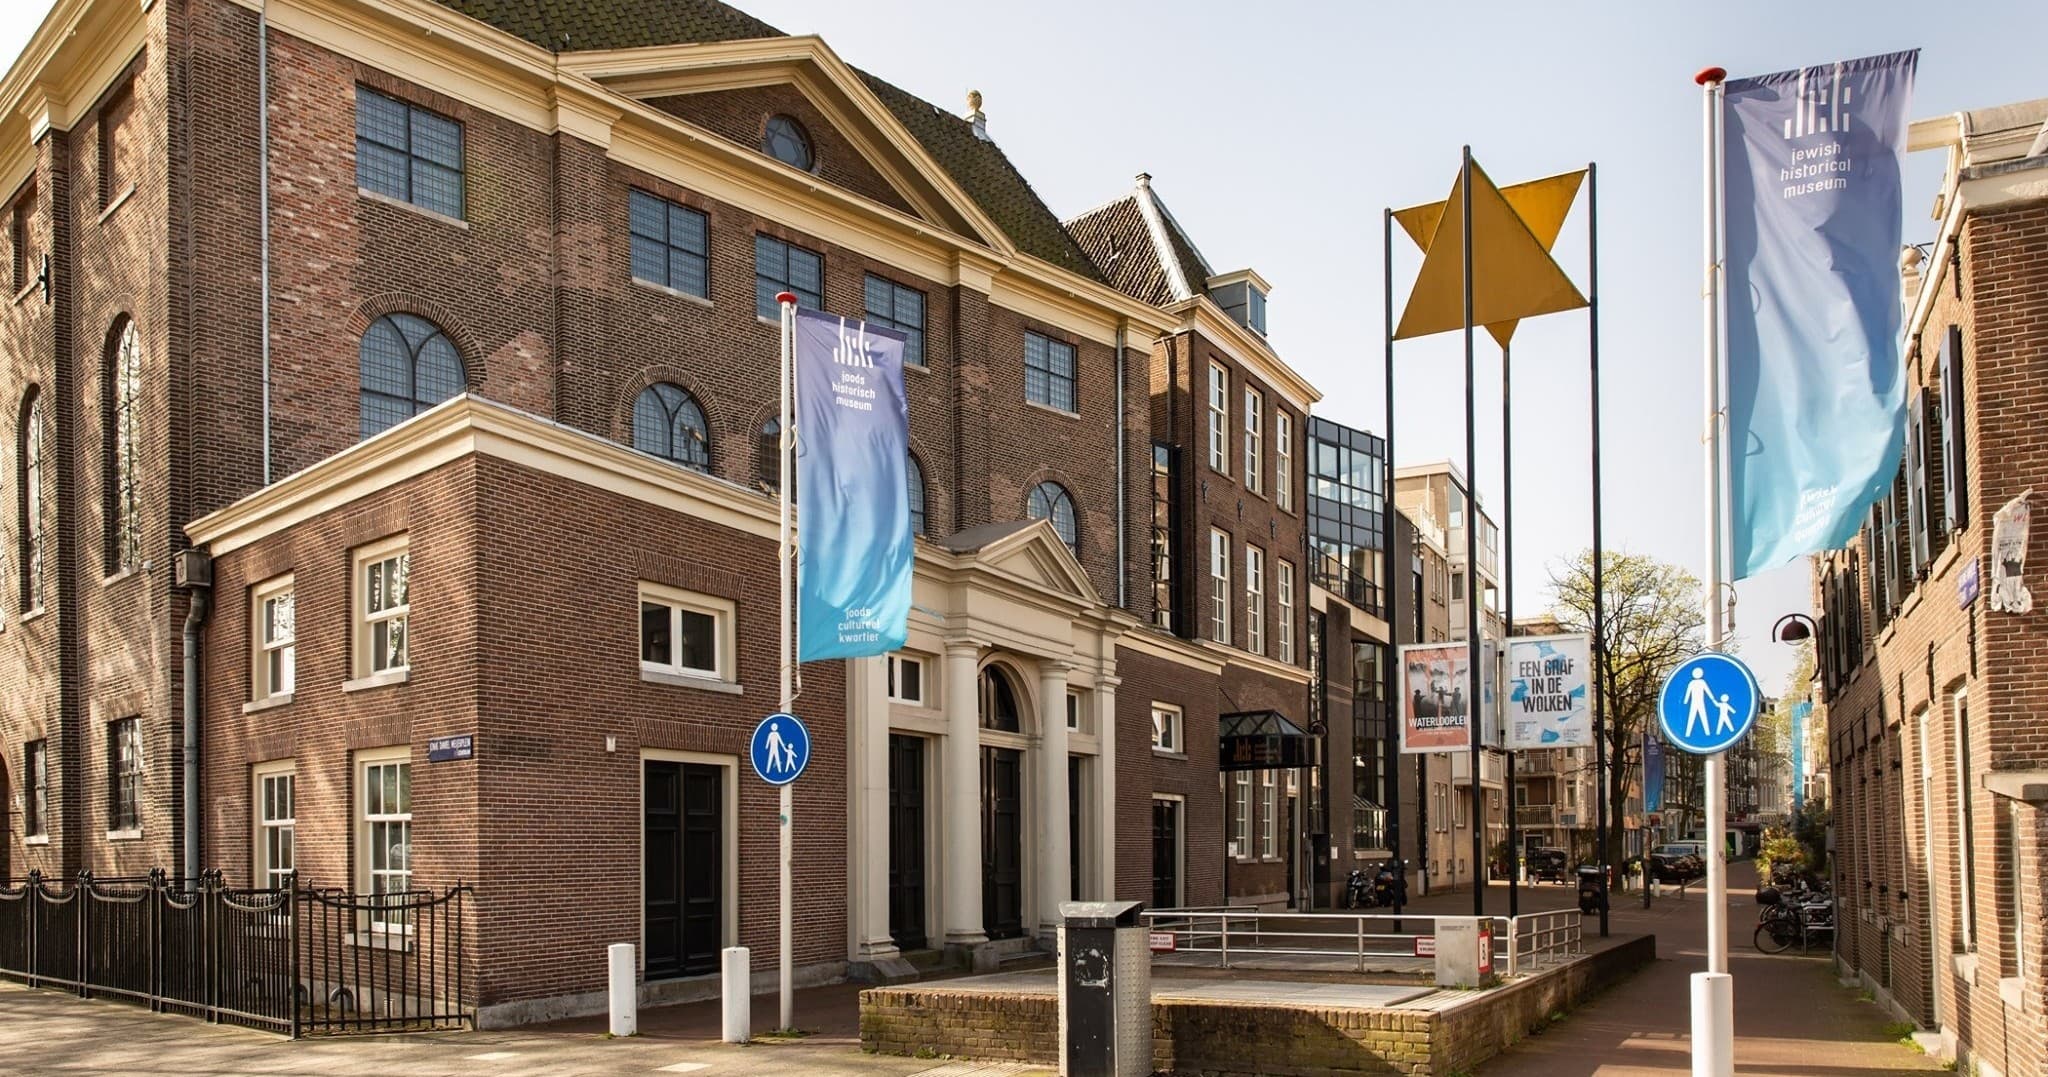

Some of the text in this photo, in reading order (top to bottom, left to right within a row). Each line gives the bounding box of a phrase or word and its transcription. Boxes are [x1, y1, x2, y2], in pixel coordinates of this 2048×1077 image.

[1791, 142, 1841, 165] jewish
[1780, 159, 1851, 181] historical
[1784, 178, 1847, 199] museum
[841, 371, 865, 385] joods
[832, 382, 876, 399] historisch
[836, 397, 872, 411] museum
[846, 607, 872, 619] joods
[839, 632, 879, 642] kwartier
[1519, 658, 1574, 677] EEN GRAF
[1531, 677, 1562, 695] IN DE
[1522, 694, 1572, 713] WOLKEN
